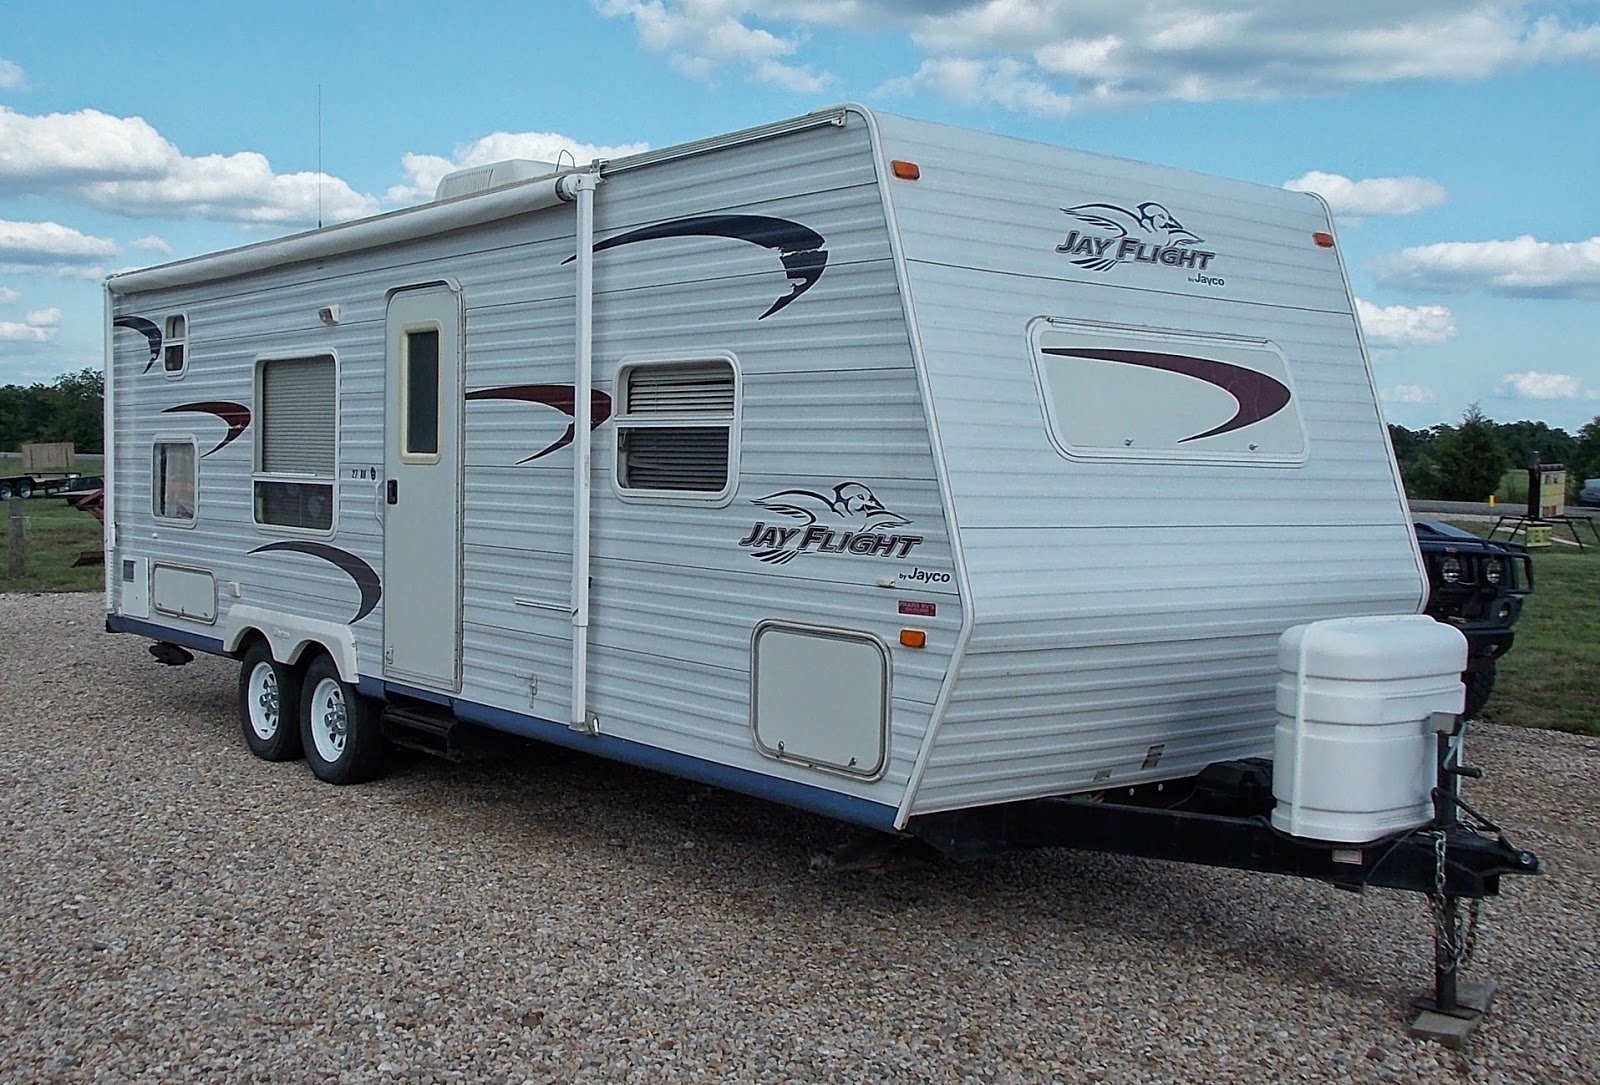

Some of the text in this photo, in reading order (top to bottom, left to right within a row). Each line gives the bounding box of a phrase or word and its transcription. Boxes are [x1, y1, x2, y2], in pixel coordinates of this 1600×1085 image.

[1055, 230, 1216, 270] JAY FLIGHT
[1194, 272, 1225, 287] Jayco
[739, 522, 923, 559] JAY FLIGHT
[898, 567, 951, 584] by Jayco
